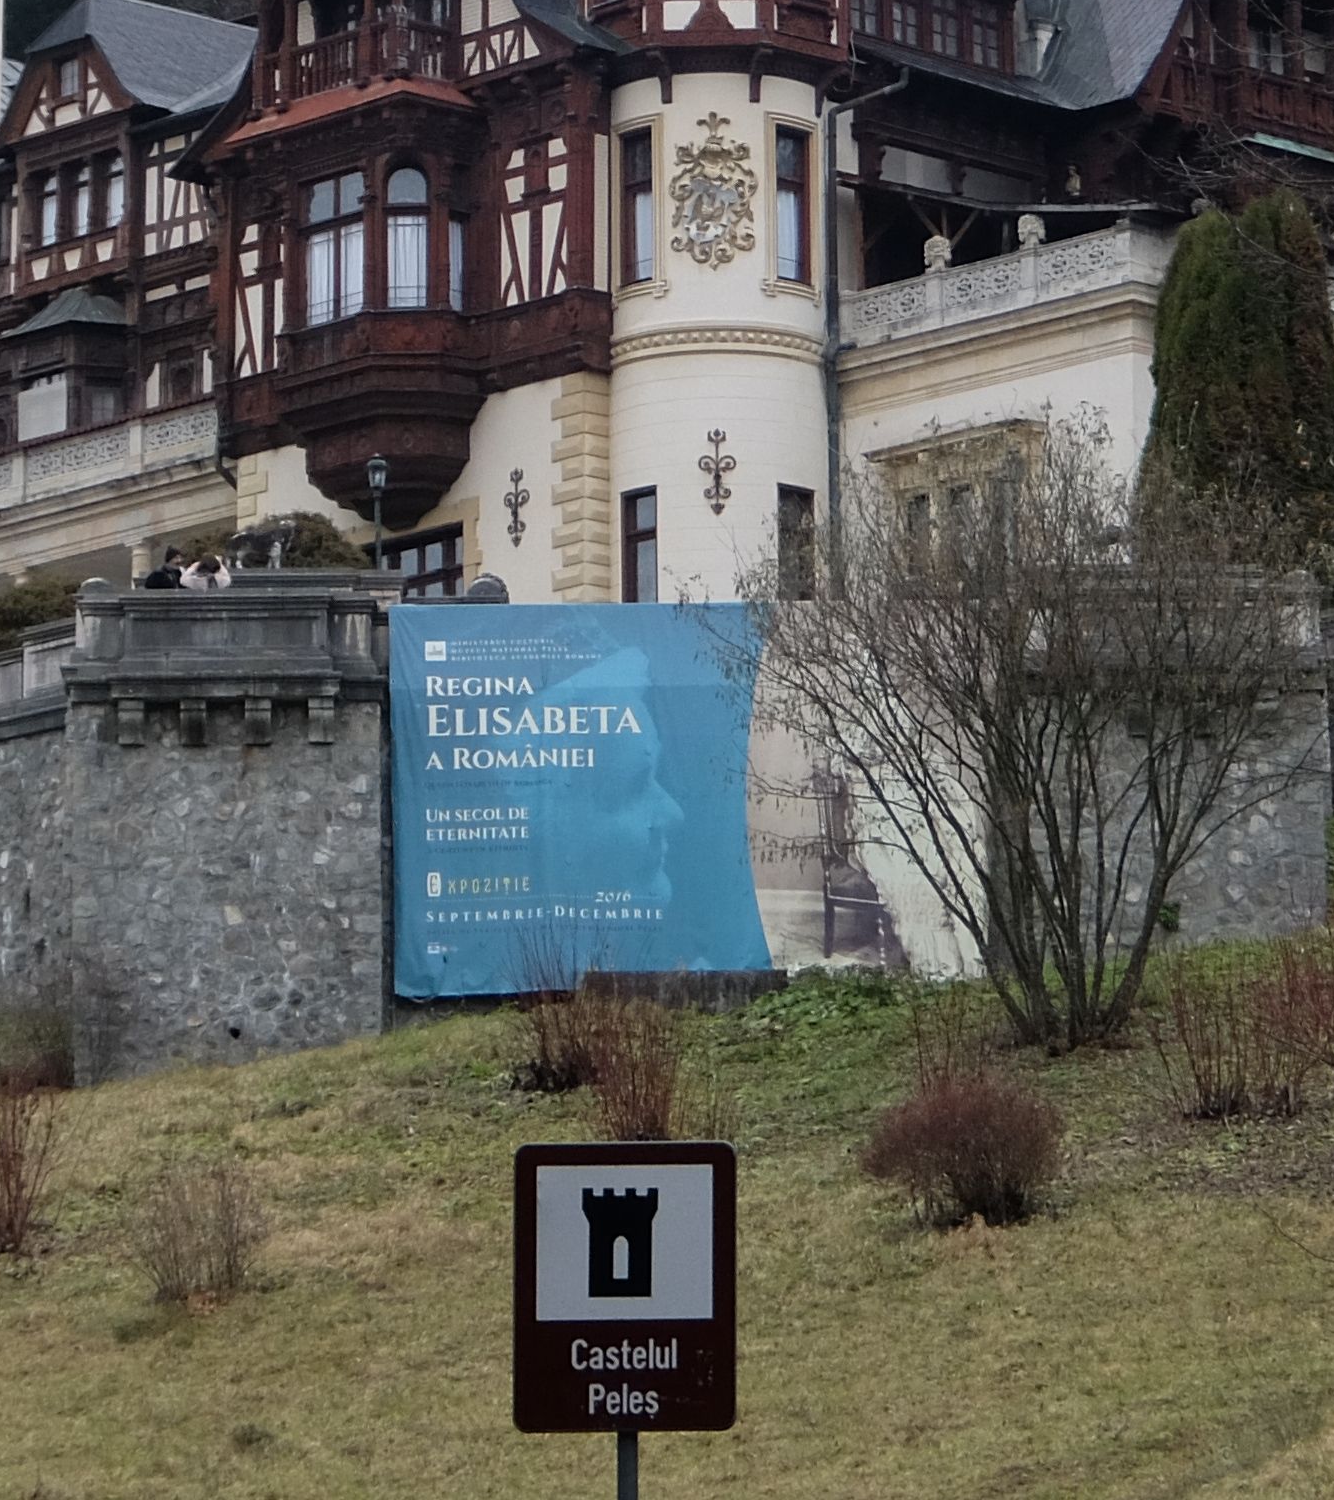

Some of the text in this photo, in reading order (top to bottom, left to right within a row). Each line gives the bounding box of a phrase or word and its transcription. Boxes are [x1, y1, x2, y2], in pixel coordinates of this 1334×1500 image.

[427, 703, 642, 737] ELISABETA
[426, 806, 530, 822] UN SECOL DE
[426, 826, 530, 841] ETERNITATE
[594, 891, 632, 903] 2016
[570, 1337, 678, 1370] Castelul
